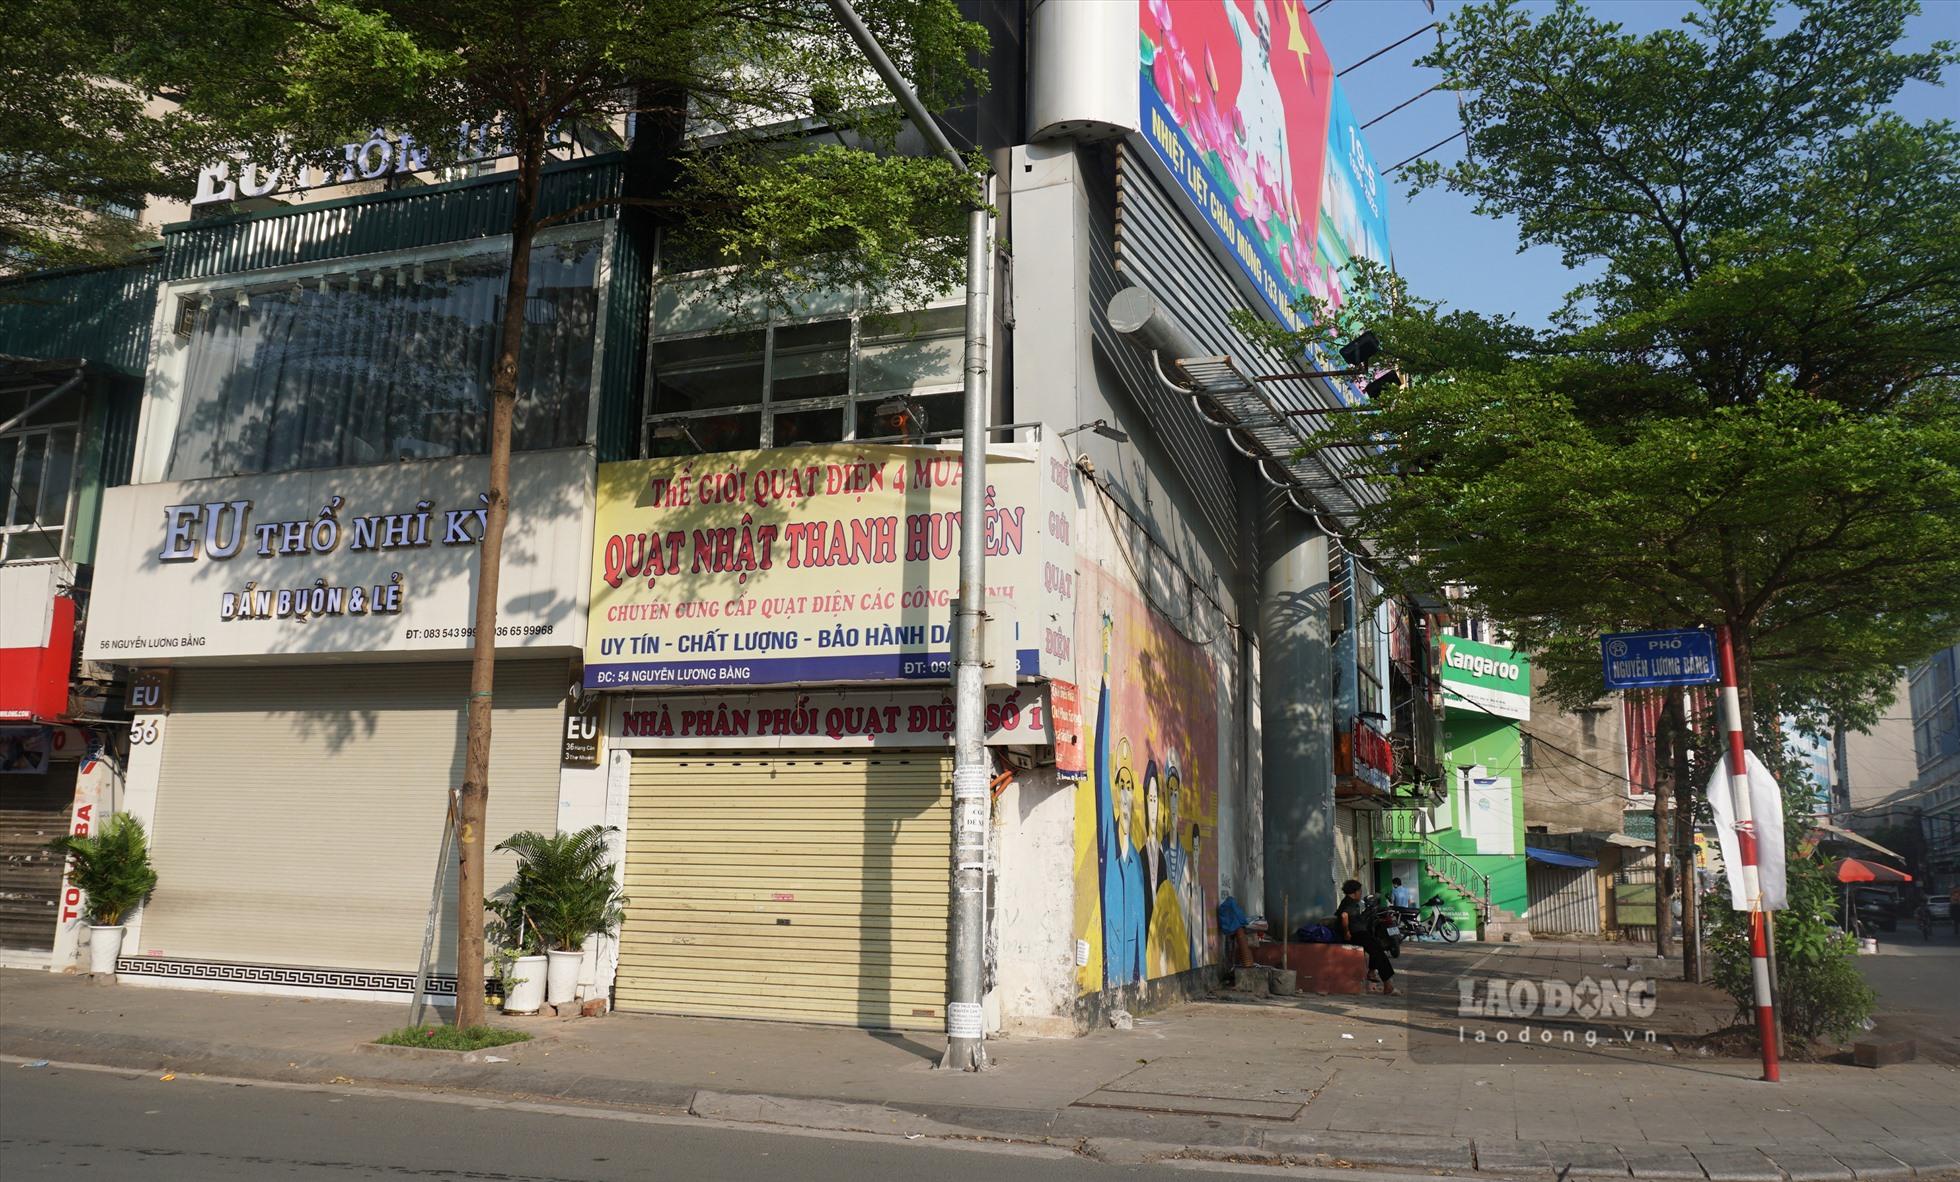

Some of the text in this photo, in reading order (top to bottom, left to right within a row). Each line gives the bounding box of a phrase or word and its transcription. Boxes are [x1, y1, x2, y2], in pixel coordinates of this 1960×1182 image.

[1152, 106, 1185, 175] NHIỆT
[1187, 157, 1208, 207] LIỆT
[1210, 191, 1235, 245] CHÀO
[1263, 269, 1278, 305] 133
[698, 463, 747, 505] GIỚI
[754, 463, 820, 508] QUẠT
[826, 455, 887, 503] ĐIỆN
[893, 463, 905, 495] 4
[1050, 456, 1069, 492] THẾ
[159, 500, 254, 563] EU
[255, 495, 345, 557] THỔ
[350, 500, 434, 552] NHĨ
[603, 485, 1025, 589] QUẠT NHẬT THANH HUỀN
[221, 581, 274, 620] BÁN
[348, 586, 367, 615] &
[372, 572, 402, 615] LẺ
[1044, 561, 1072, 601] QUẠT
[607, 599, 671, 622] CHUYÊN
[724, 591, 758, 617] CẤP
[761, 597, 807, 620] QUẠT
[812, 589, 855, 617] ĐIỆN
[860, 587, 895, 611] CÁC
[901, 585, 950, 609] CÔNG
[100, 641, 110, 649] 56
[406, 629, 422, 639] ĐT:
[424, 629, 440, 639] 083
[442, 628, 460, 638] 543
[510, 626, 522, 636] 65
[523, 625, 553, 636] 99968
[600, 637, 626, 656] UY
[630, 633, 660, 655] TÍN
[678, 628, 729, 653] CHẤT
[734, 631, 798, 654] LƯỢNG
[818, 624, 859, 648] BẢO
[865, 624, 924, 646] HÀNH
[1045, 625, 1071, 666] ĐIỆN
[1648, 635, 1682, 650] PHỐ
[597, 665, 750, 683] ĐC: 54 NGUYỄN LƯƠNG BẰNG
[904, 662, 926, 674] ĐT:
[1441, 642, 1519, 681] Kangaroo
[132, 686, 160, 706] EU
[129, 719, 158, 744] 56
[567, 716, 597, 740] EU
[622, 704, 674, 736] NHÀ
[680, 703, 750, 736] PHÂN
[757, 695, 819, 736] PHỐI
[825, 705, 901, 741] QUẠT
[908, 696, 956, 740] ĐIỆ
[985, 690, 1021, 732] SỐ
[1029, 706, 1044, 730] 1
